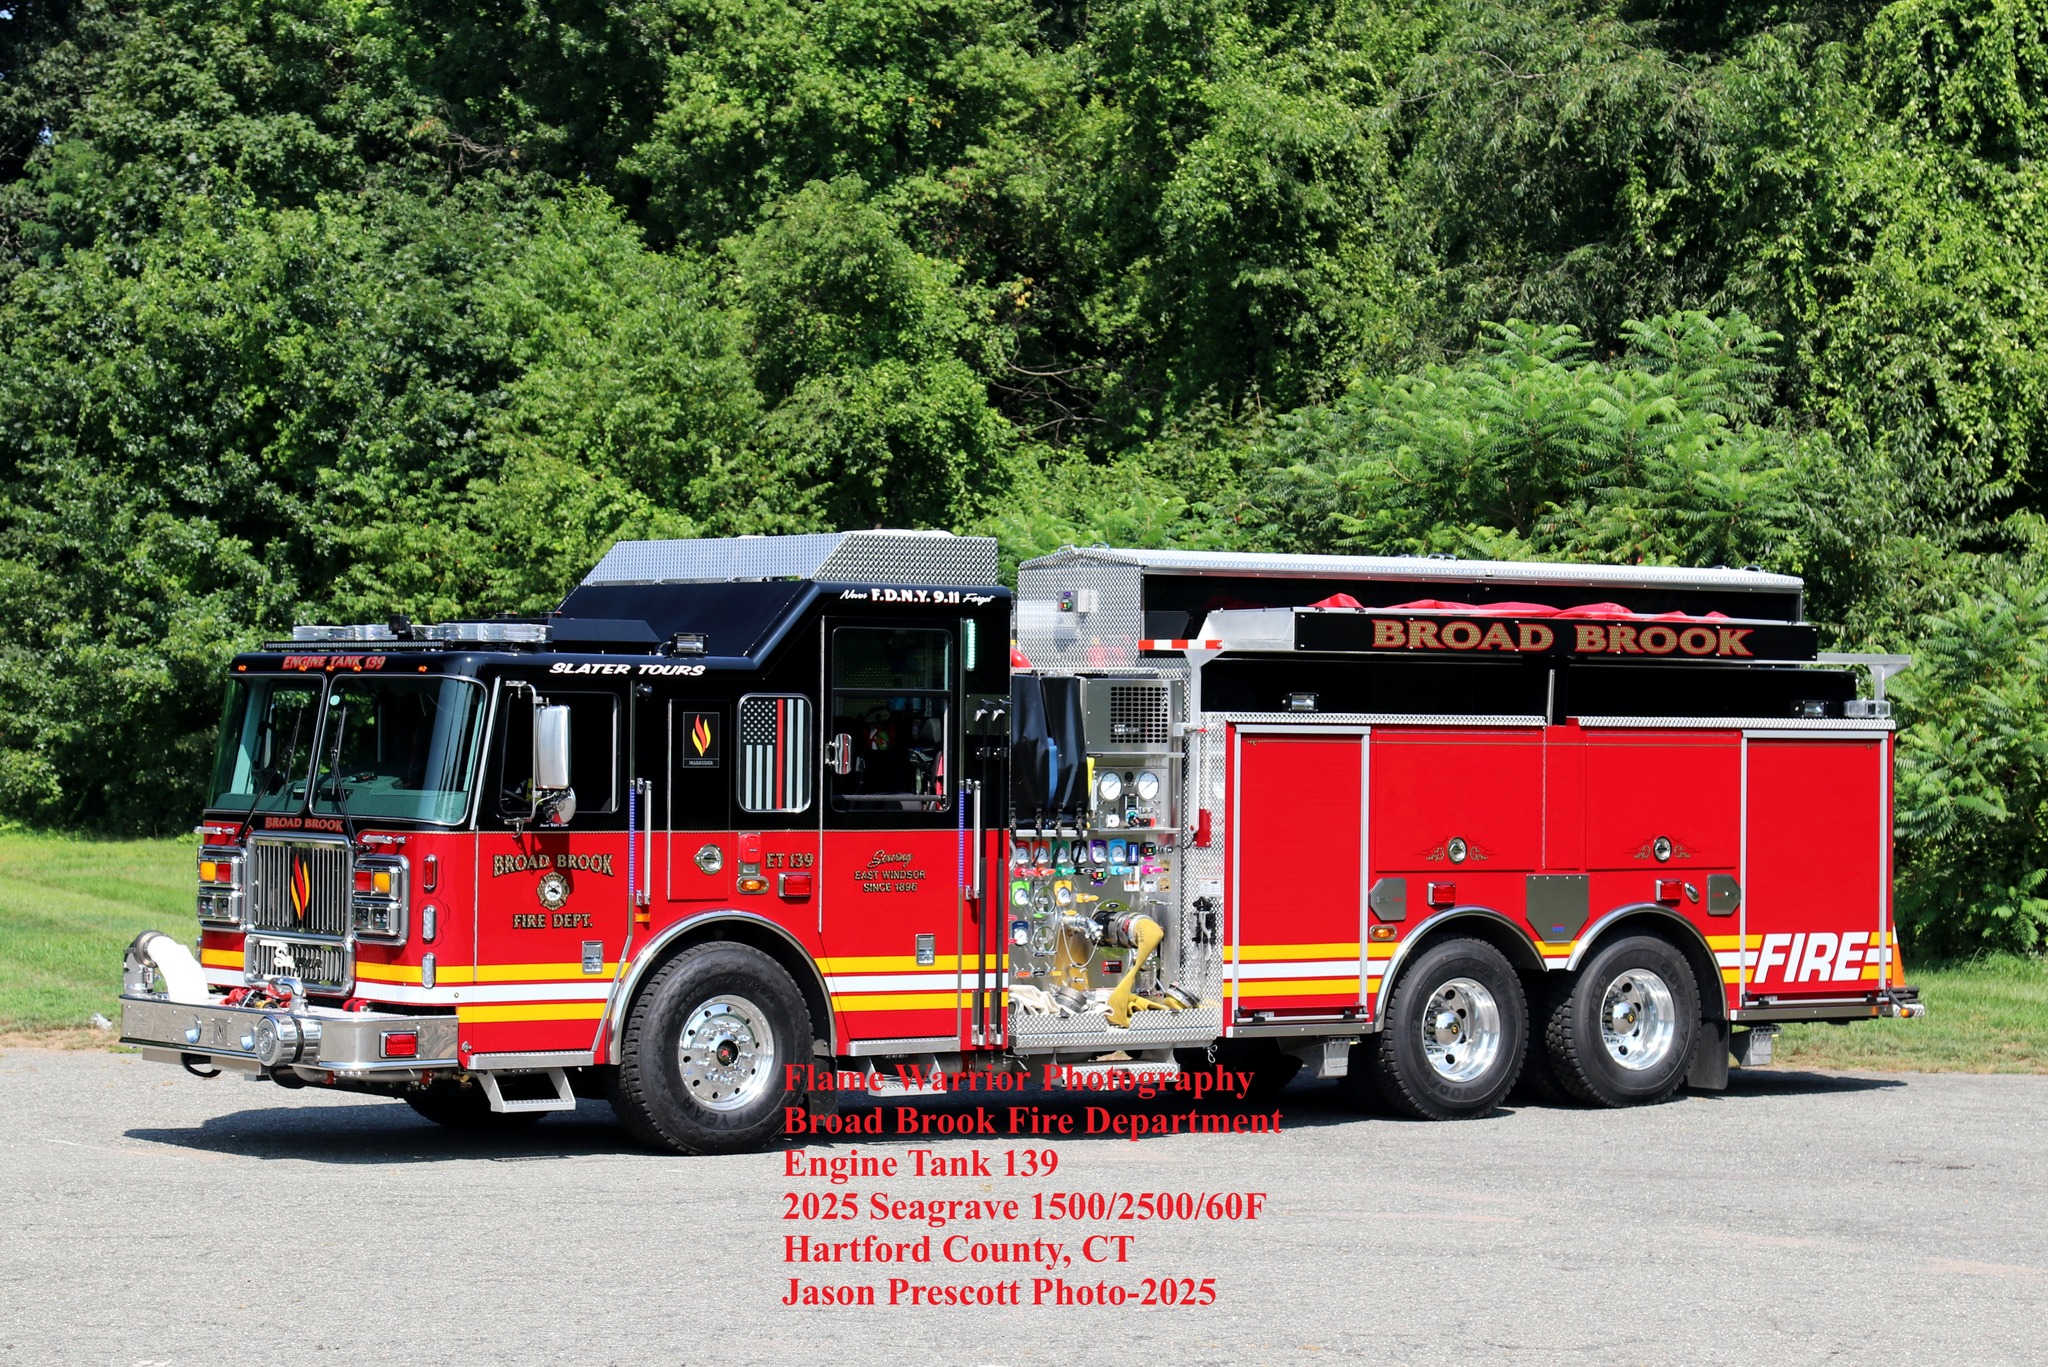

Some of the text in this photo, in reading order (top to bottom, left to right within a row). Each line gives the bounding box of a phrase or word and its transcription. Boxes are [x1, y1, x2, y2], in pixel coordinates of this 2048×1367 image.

[962, 593, 995, 606] Forget
[1371, 619, 1754, 656] BROAD BROOK
[282, 655, 386, 670] ENGINE TANK 139
[549, 662, 706, 676] SLATER TOURS
[264, 816, 344, 833] BROAD BROOK
[493, 854, 614, 877] BROAD BROOK
[766, 852, 814, 868] ET 139
[867, 849, 913, 868] Serving
[854, 869, 926, 880] EAST WINDSOR
[863, 882, 891, 893] SINCE
[513, 913, 593, 929] FIRE DEPT.
[1753, 931, 1869, 983] FIRE
